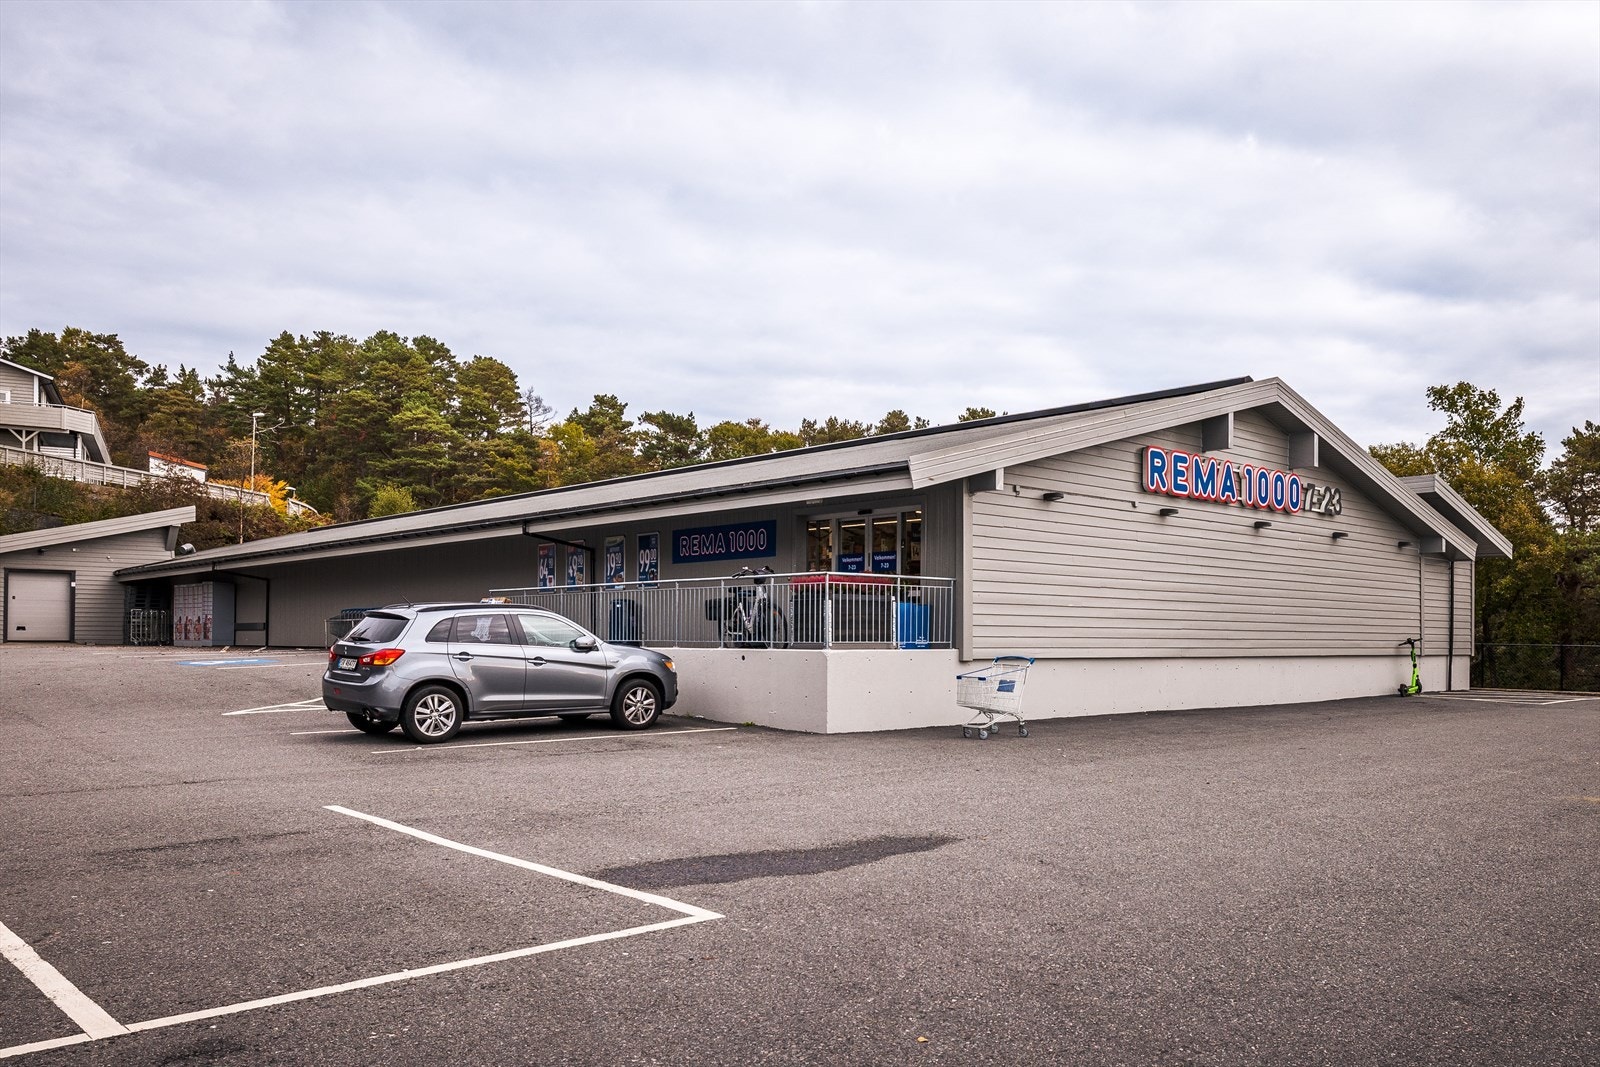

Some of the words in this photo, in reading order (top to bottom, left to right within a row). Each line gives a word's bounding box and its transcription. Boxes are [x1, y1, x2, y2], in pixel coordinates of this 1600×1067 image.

[1146, 446, 1238, 504] REMA
[1242, 464, 1302, 514] 1000
[1304, 483, 1342, 515] 7-23
[679, 532, 726, 557] REMA
[729, 528, 767, 553] 1000
[539, 558, 548, 579] 64
[568, 555, 578, 577] 49
[607, 553, 616, 577] 19
[639, 549, 650, 573] 99
